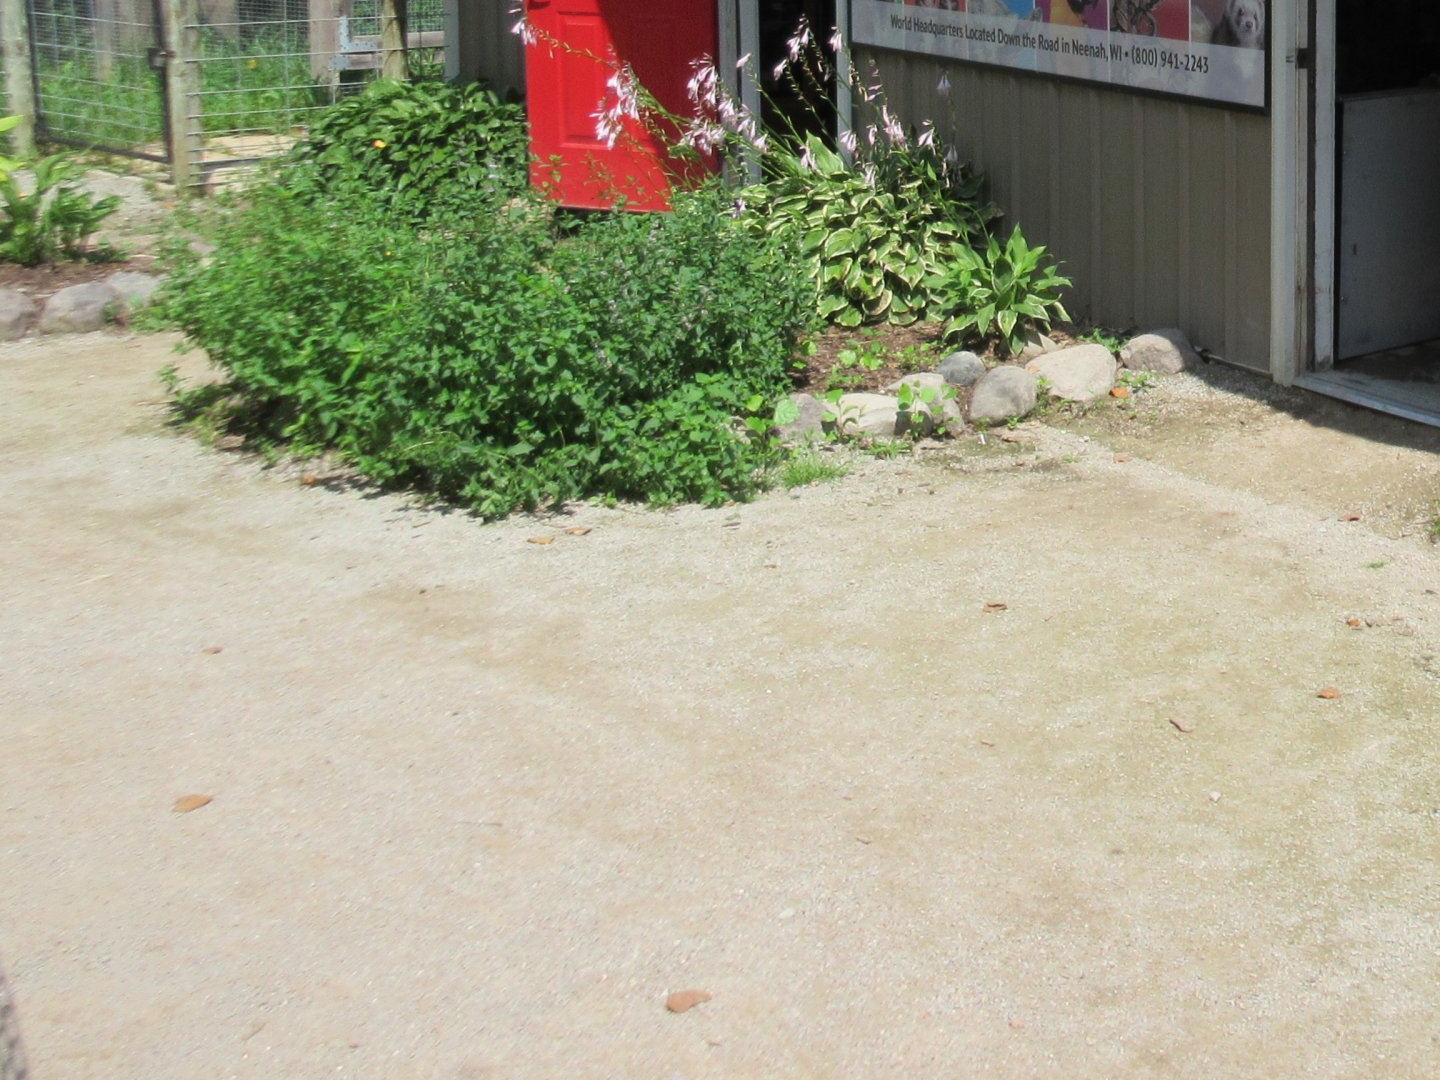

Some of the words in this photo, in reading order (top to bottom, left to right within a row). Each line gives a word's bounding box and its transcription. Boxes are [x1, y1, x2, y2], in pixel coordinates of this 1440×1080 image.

[890, 14, 912, 31] World
[913, 20, 963, 38] Headquarters
[965, 24, 996, 43] Located
[998, 29, 1020, 46] Down
[1022, 31, 1037, 48] the
[1038, 34, 1059, 52] Road
[1061, 37, 1070, 54] in
[1072, 39, 1108, 62] Neenah,
[1109, 44, 1122, 61] WI
[1131, 44, 1158, 67] (800)
[1161, 50, 1209, 73] 941-2243
